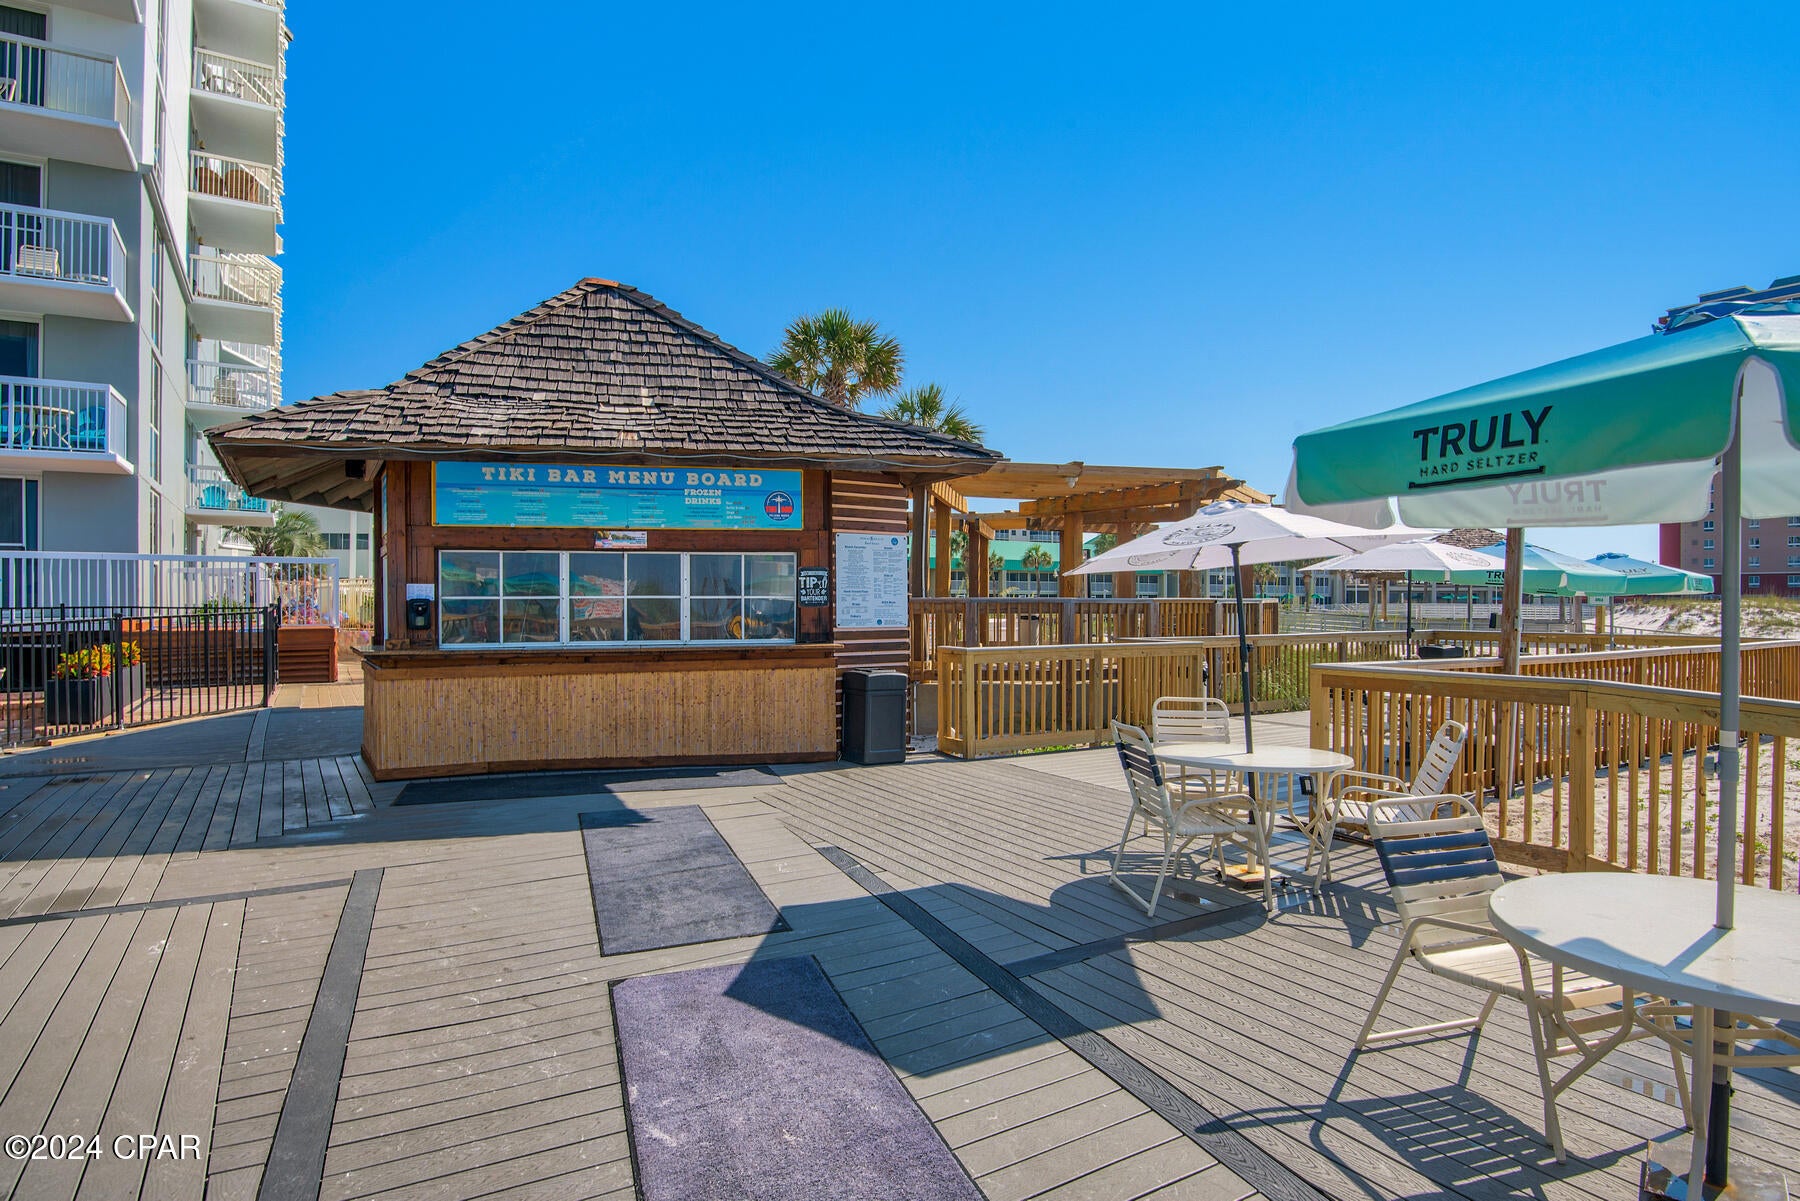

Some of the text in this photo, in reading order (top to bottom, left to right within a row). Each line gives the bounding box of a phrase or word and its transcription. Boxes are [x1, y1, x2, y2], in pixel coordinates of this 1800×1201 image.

[1413, 405, 1553, 461] TRULY
[1419, 451, 1539, 477] HARD SELTZER
[482, 467, 763, 487] TIKI BAR MENU BOARD
[684, 488, 722, 496] FROZEN
[685, 497, 722, 505] DRINKS
[799, 577, 817, 588] TIP
